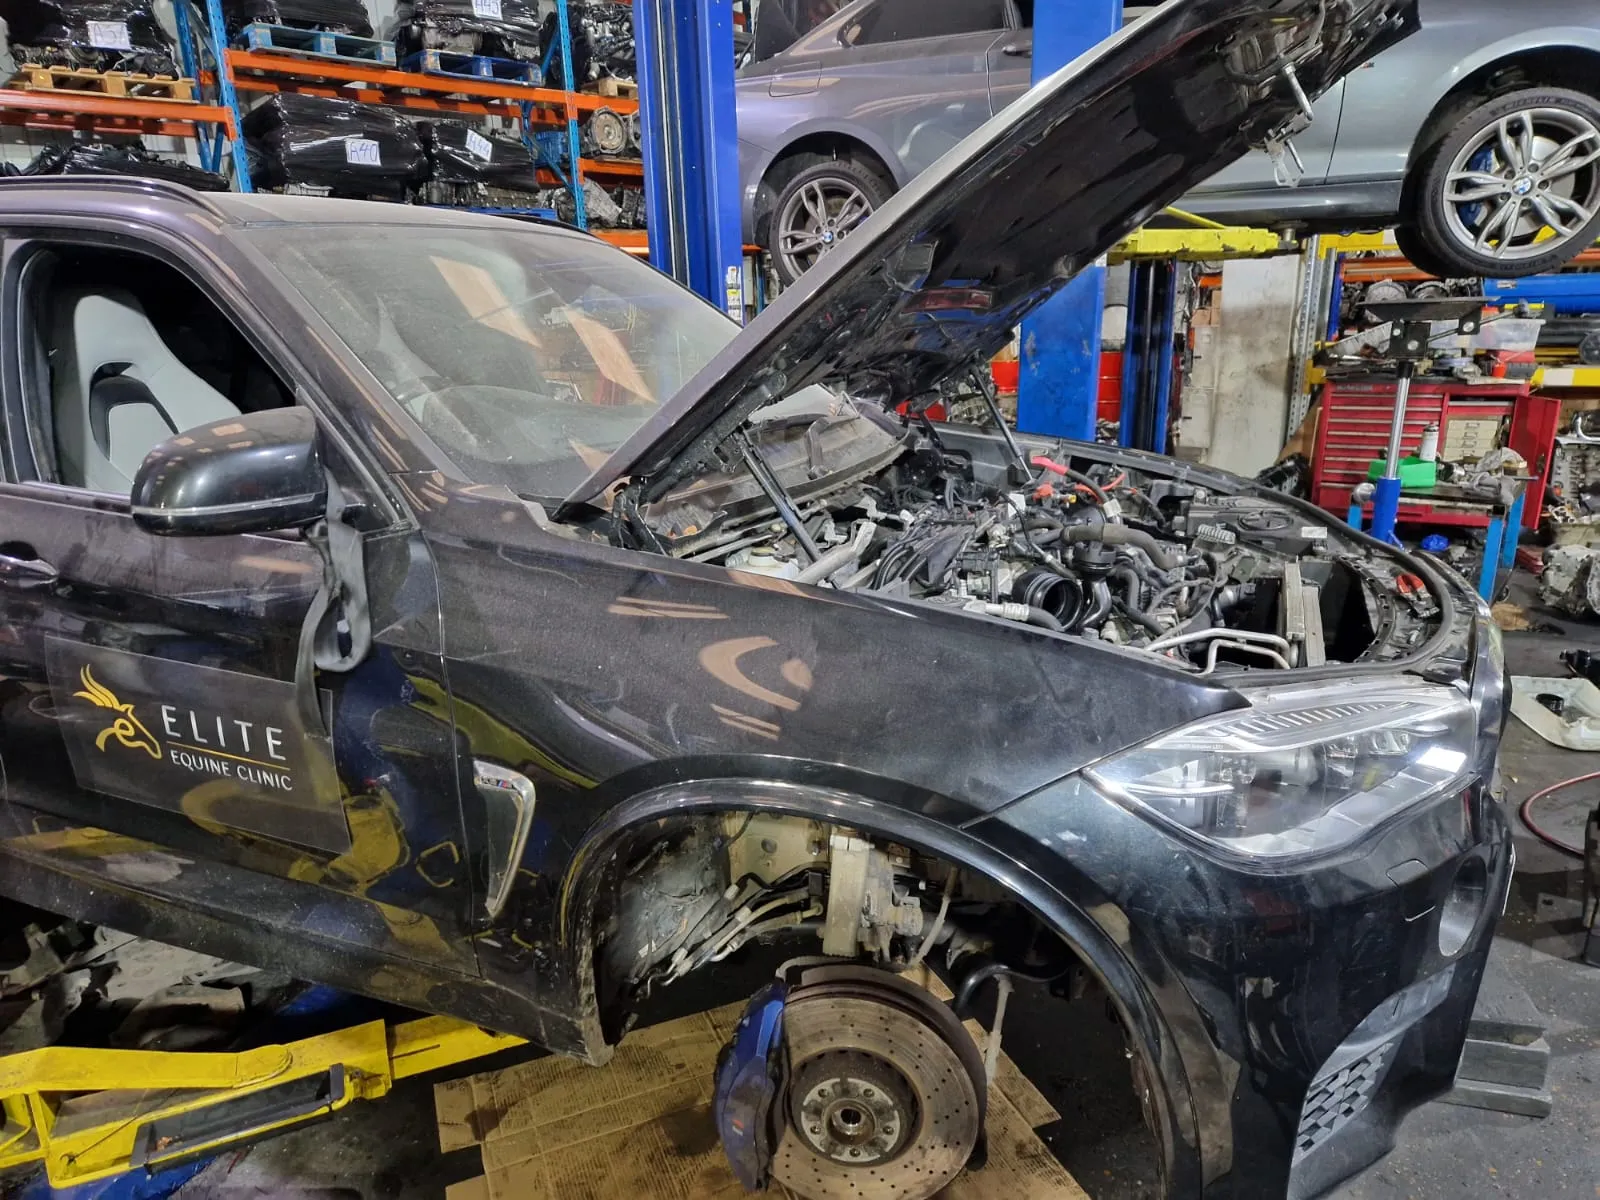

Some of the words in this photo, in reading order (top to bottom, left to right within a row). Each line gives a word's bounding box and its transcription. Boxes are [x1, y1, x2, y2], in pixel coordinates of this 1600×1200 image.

[350, 142, 378, 162] A40
[161, 704, 286, 761] ELITE
[170, 749, 232, 777] EQUINE
[236, 764, 293, 791] CLINIC
